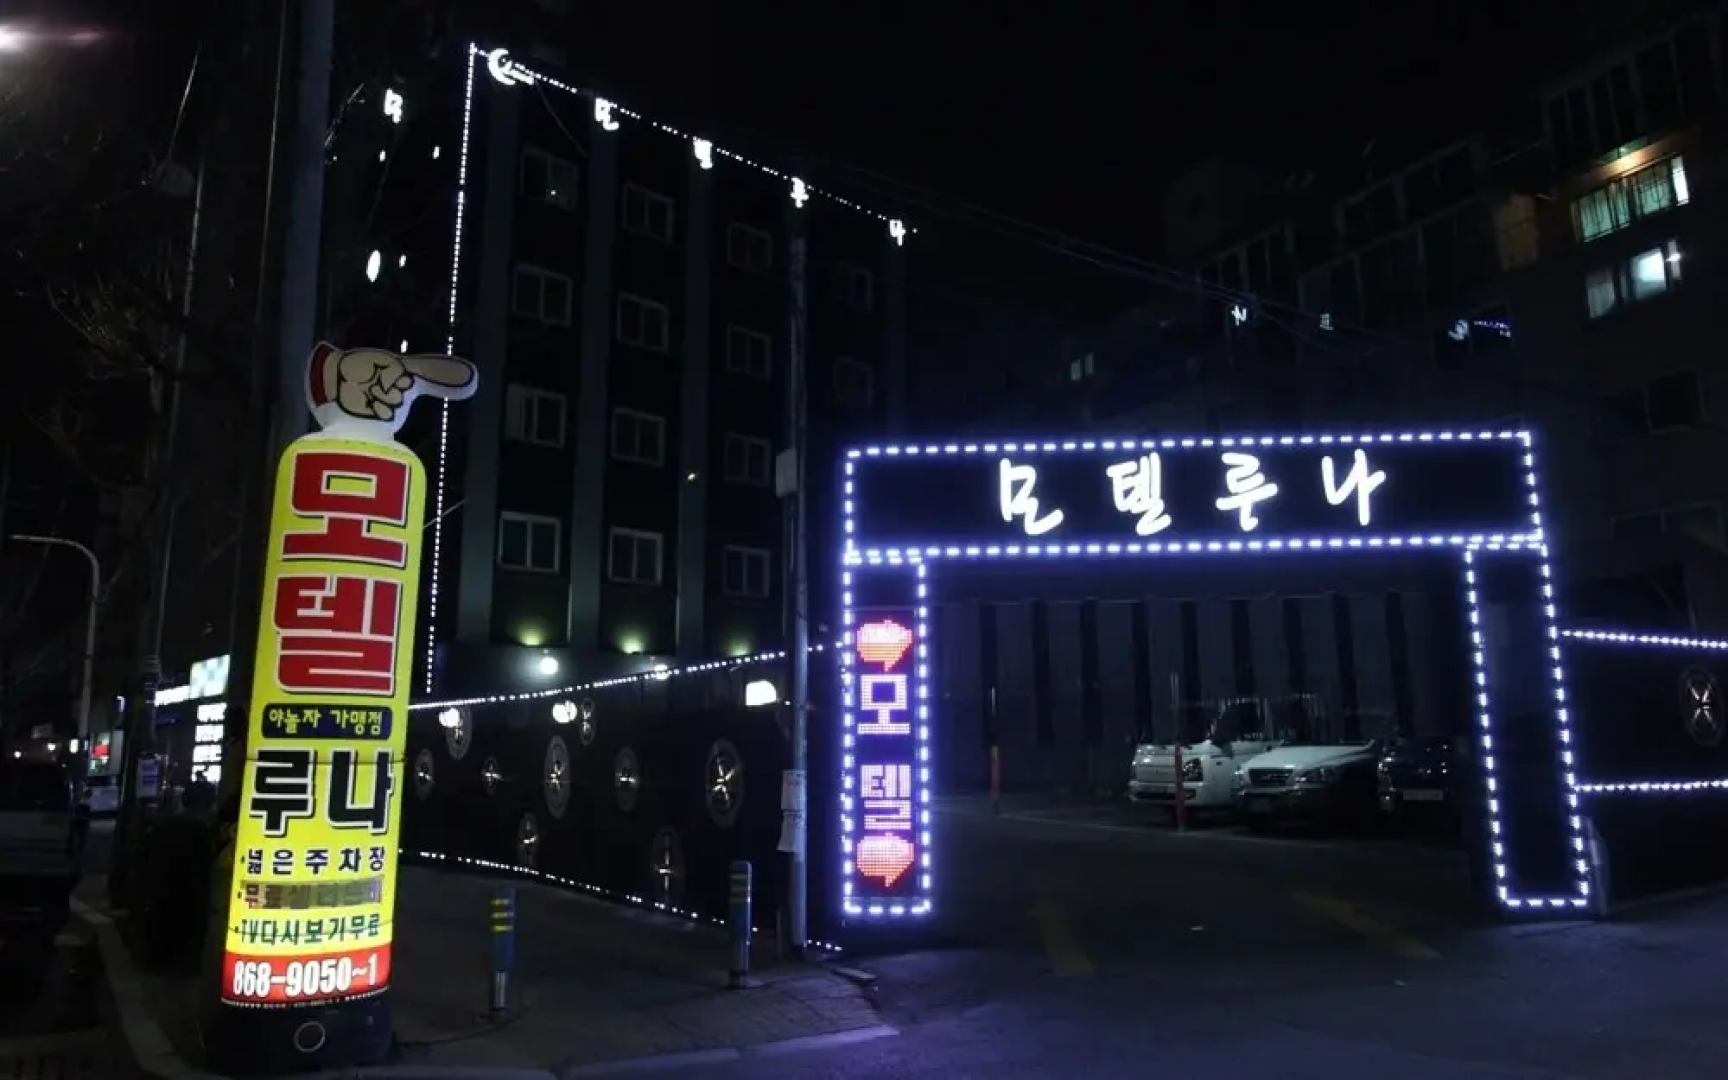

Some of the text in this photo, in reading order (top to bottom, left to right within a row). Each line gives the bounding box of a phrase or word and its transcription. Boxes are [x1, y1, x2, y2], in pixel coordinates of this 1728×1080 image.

[272, 449, 411, 696] 모텔
[269, 707, 382, 735] 야놀자 가맹점
[857, 674, 911, 830] 모텔
[249, 746, 394, 838] 루나
